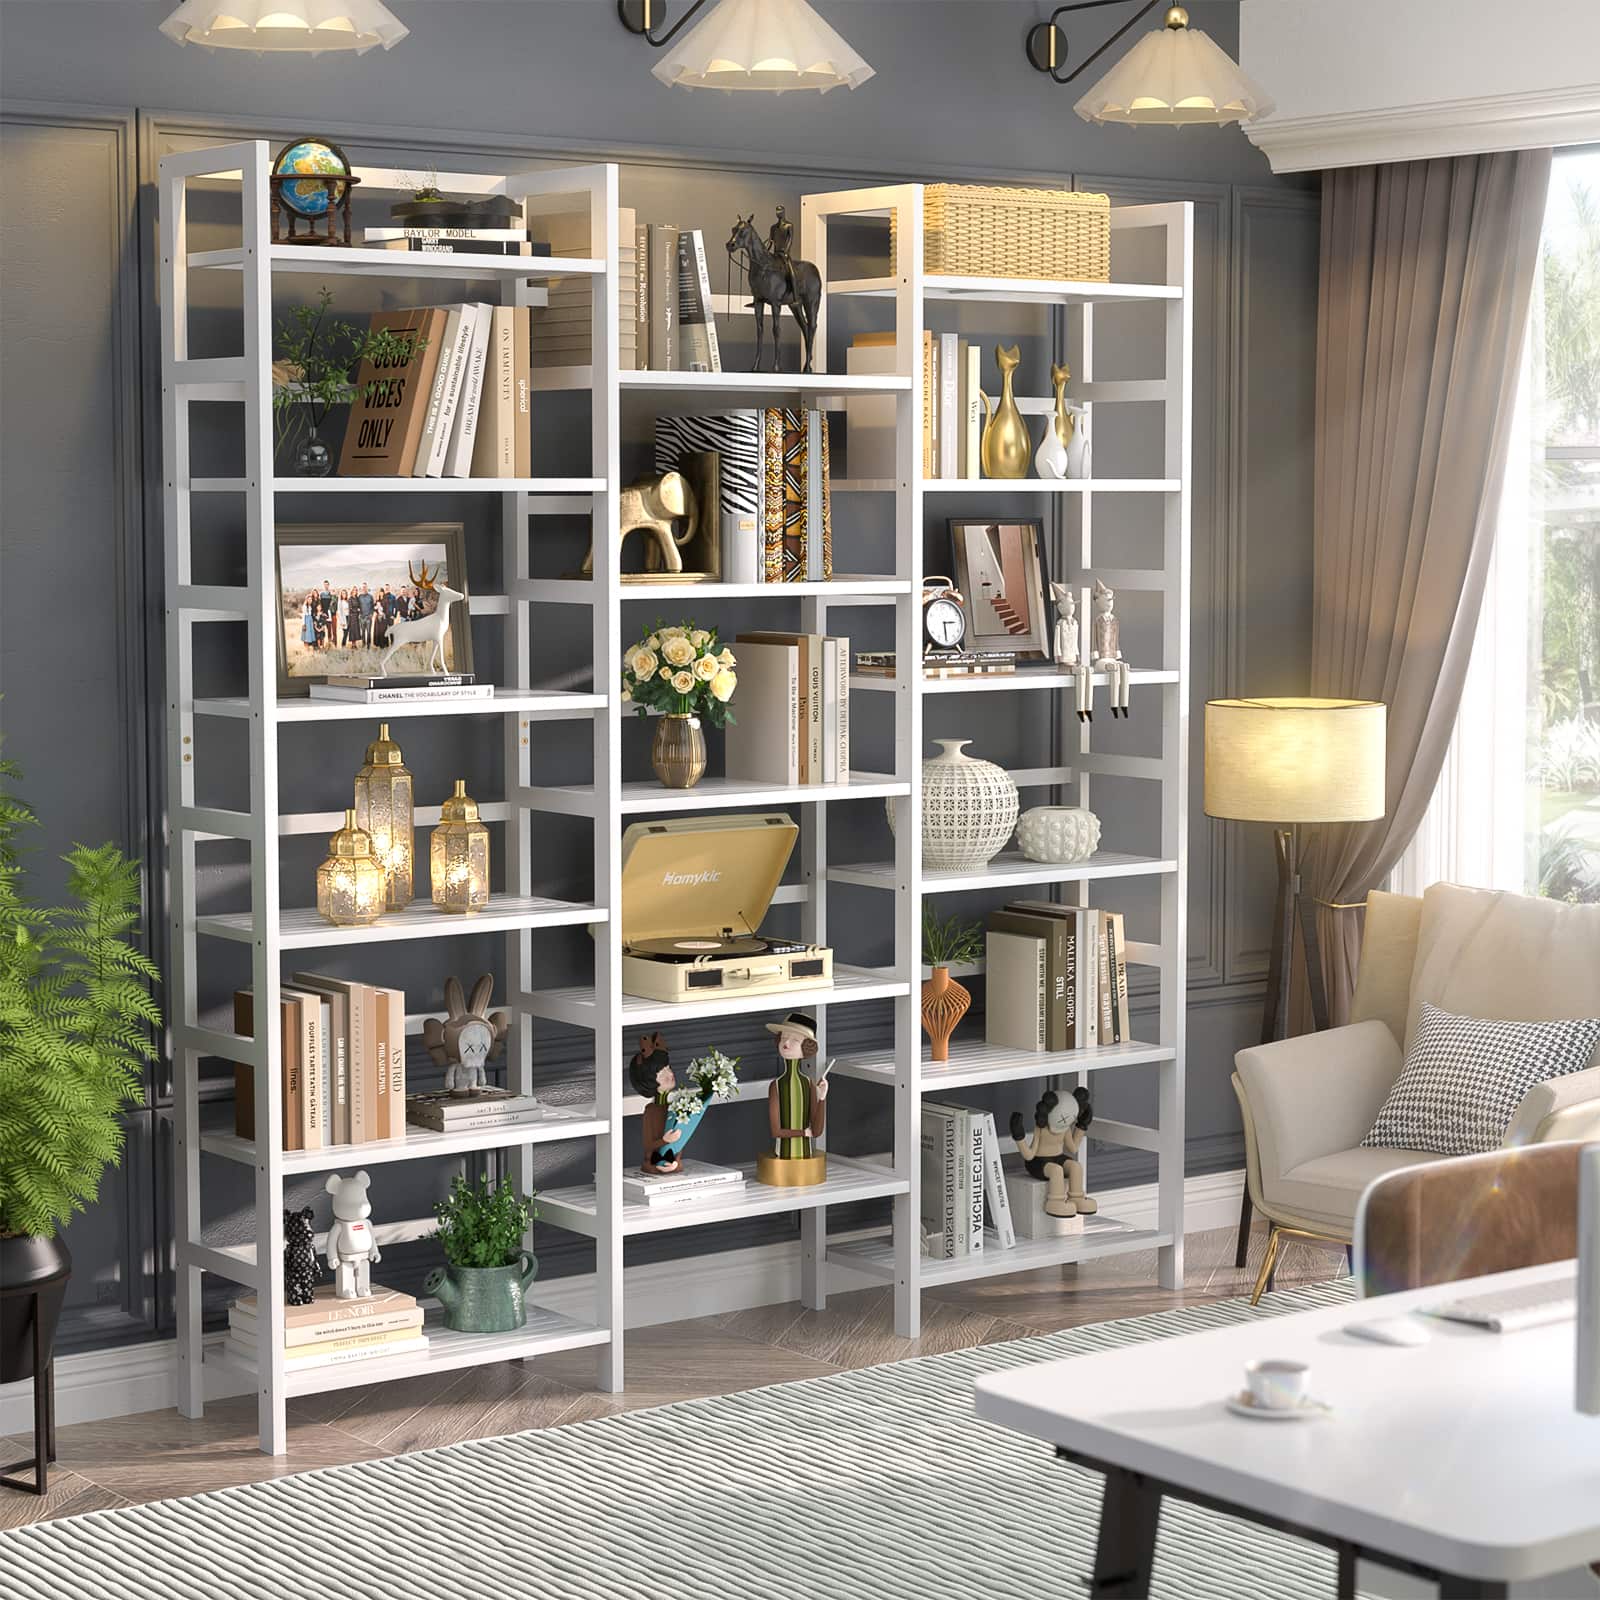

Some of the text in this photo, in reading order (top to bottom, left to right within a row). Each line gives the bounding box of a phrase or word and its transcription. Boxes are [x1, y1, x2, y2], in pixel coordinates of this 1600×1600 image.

[404, 229, 476, 238] BAYLOR MODEL
[639, 282, 648, 322] Revolution
[443, 405, 452, 416] for
[448, 355, 463, 397] sustainable
[456, 324, 470, 355] lifestyle
[503, 328, 511, 402] ON IMMUNITY
[364, 378, 406, 408] VIBES
[426, 416, 437, 434] THIS
[434, 374, 446, 398] GOOD
[440, 347, 450, 373] GUIDE
[464, 404, 476, 436] DREAM
[473, 346, 483, 378] AWAKE
[517, 379, 528, 413] spherical
[944, 380, 954, 408] Dior
[358, 418, 394, 448] ONLY
[840, 698, 847, 708] BY
[1056, 976, 1064, 1000] STILL
[1066, 936, 1075, 1027] MALLIKA CHOPRA
[1118, 962, 1126, 998] PRADA
[1102, 992, 1112, 1030] mayhem
[290, 1068, 298, 1094] lines.
[378, 1042, 386, 1095] PHILADELPHIA
[392, 1048, 402, 1092] ASTRID
